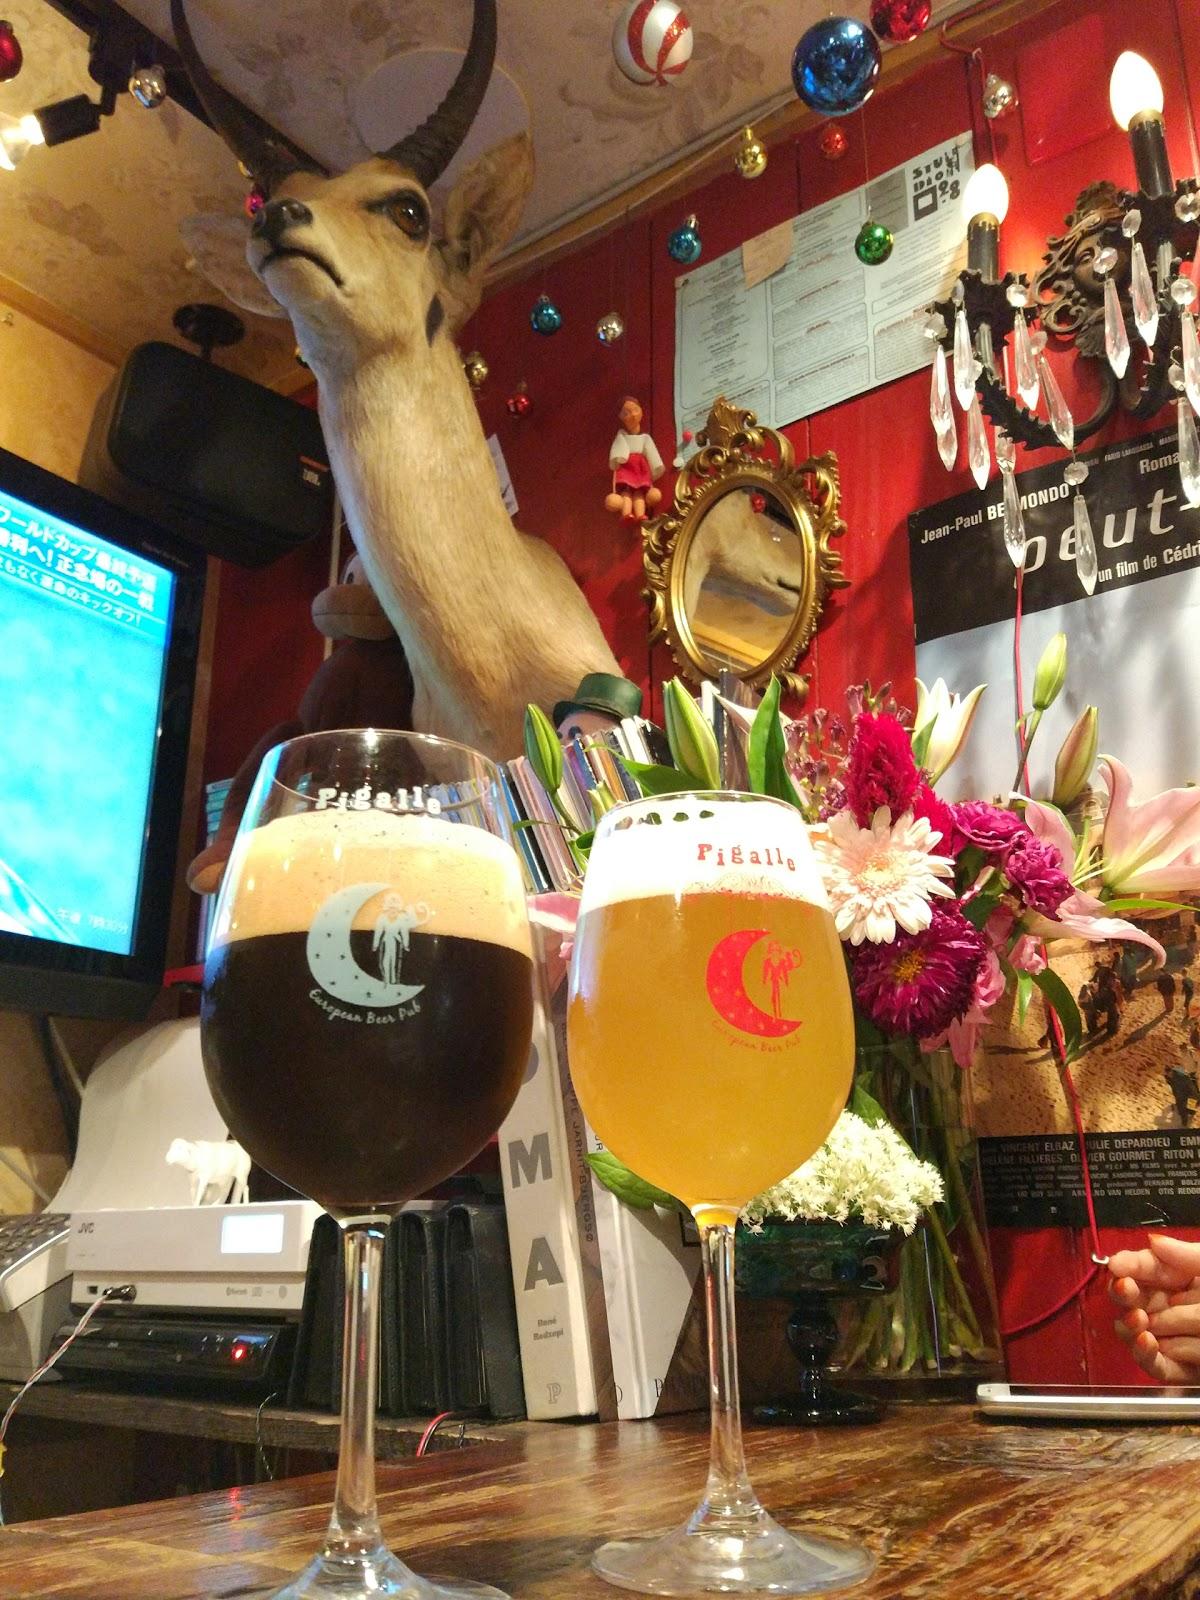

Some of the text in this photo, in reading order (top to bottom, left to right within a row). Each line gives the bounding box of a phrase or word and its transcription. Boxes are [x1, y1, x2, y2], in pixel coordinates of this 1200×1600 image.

[1140, 452, 1180, 474] Roma
[921, 482, 1070, 544] Jean-Paul BEMONDO
[1098, 568, 1112, 582] un
[1116, 561, 1138, 577] film
[1143, 554, 1157, 570] de
[315, 782, 442, 815] Pigalle
[697, 844, 796, 871] Pigalle
[366, 1011, 395, 1024] Beer
[399, 1000, 421, 1021] Pub
[1109, 1151, 1155, 1161] GOURMET
[1163, 1149, 1194, 1159] RITON
[1115, 1137, 1170, 1149] DEPARDIEU
[78, 1222, 95, 1234] JVC
